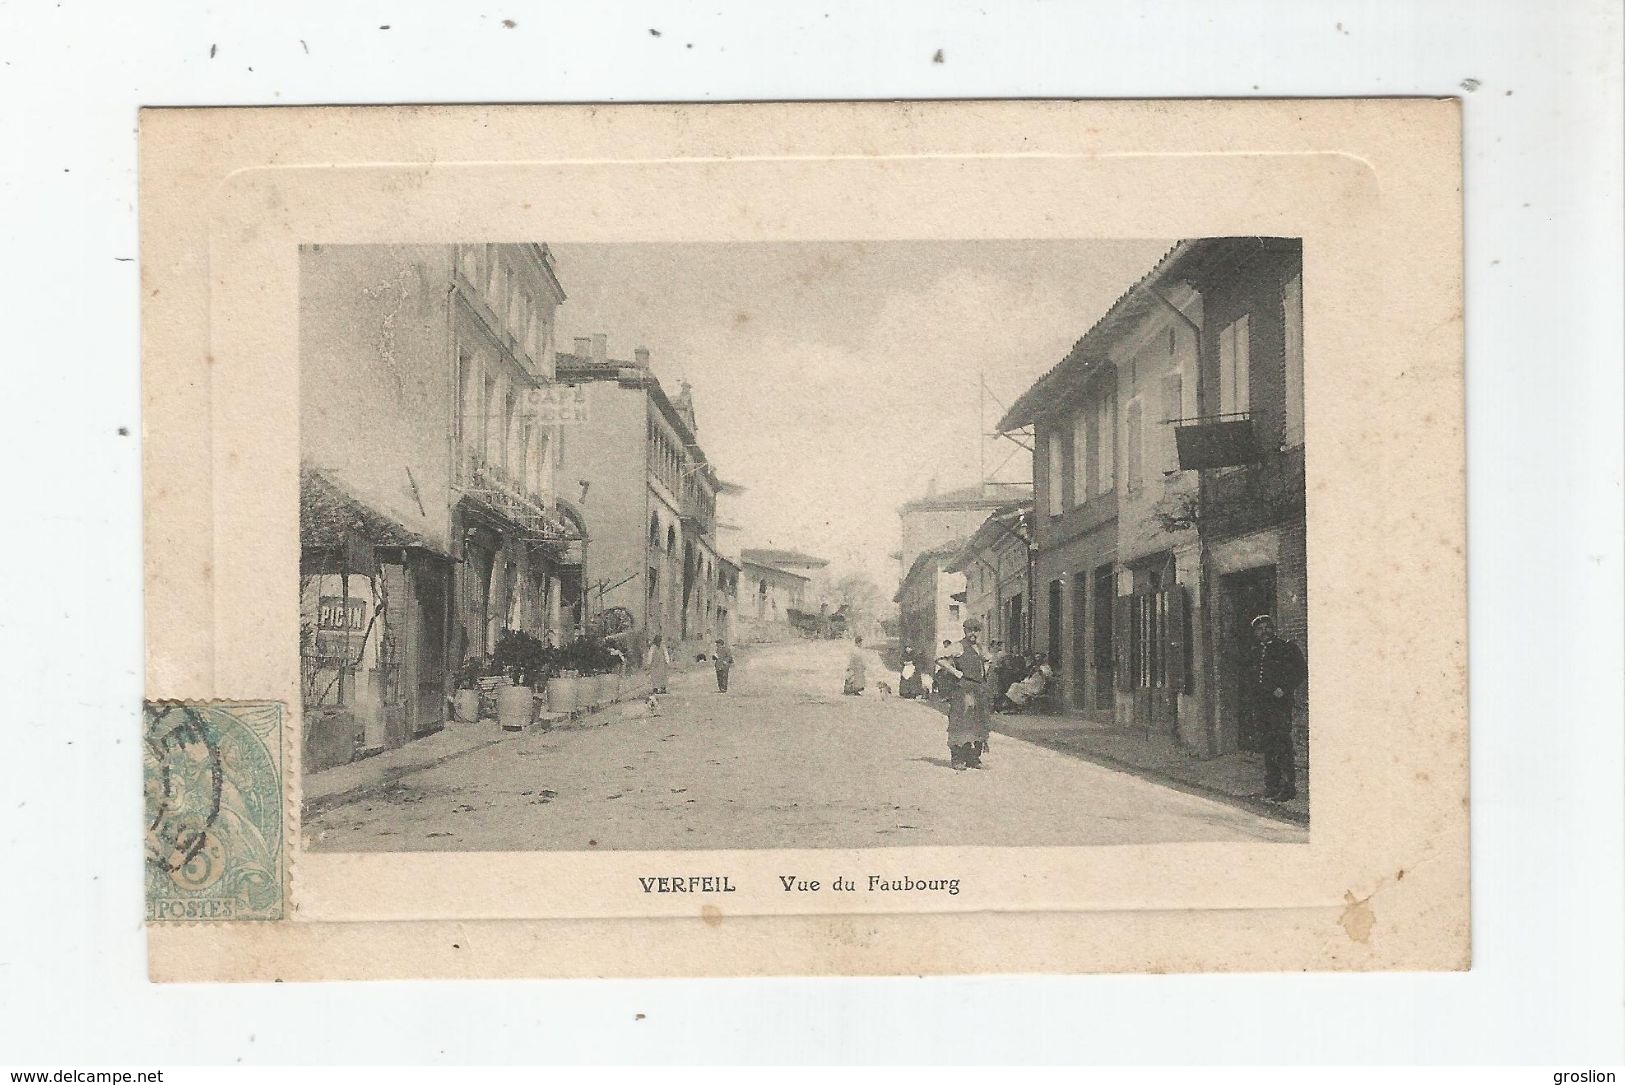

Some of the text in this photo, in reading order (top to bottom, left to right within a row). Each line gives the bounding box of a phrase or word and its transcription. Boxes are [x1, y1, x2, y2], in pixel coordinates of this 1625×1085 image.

[638, 875, 961, 896] VERFEIL Vue du Faubourg
[158, 900, 233, 919] POSTES
